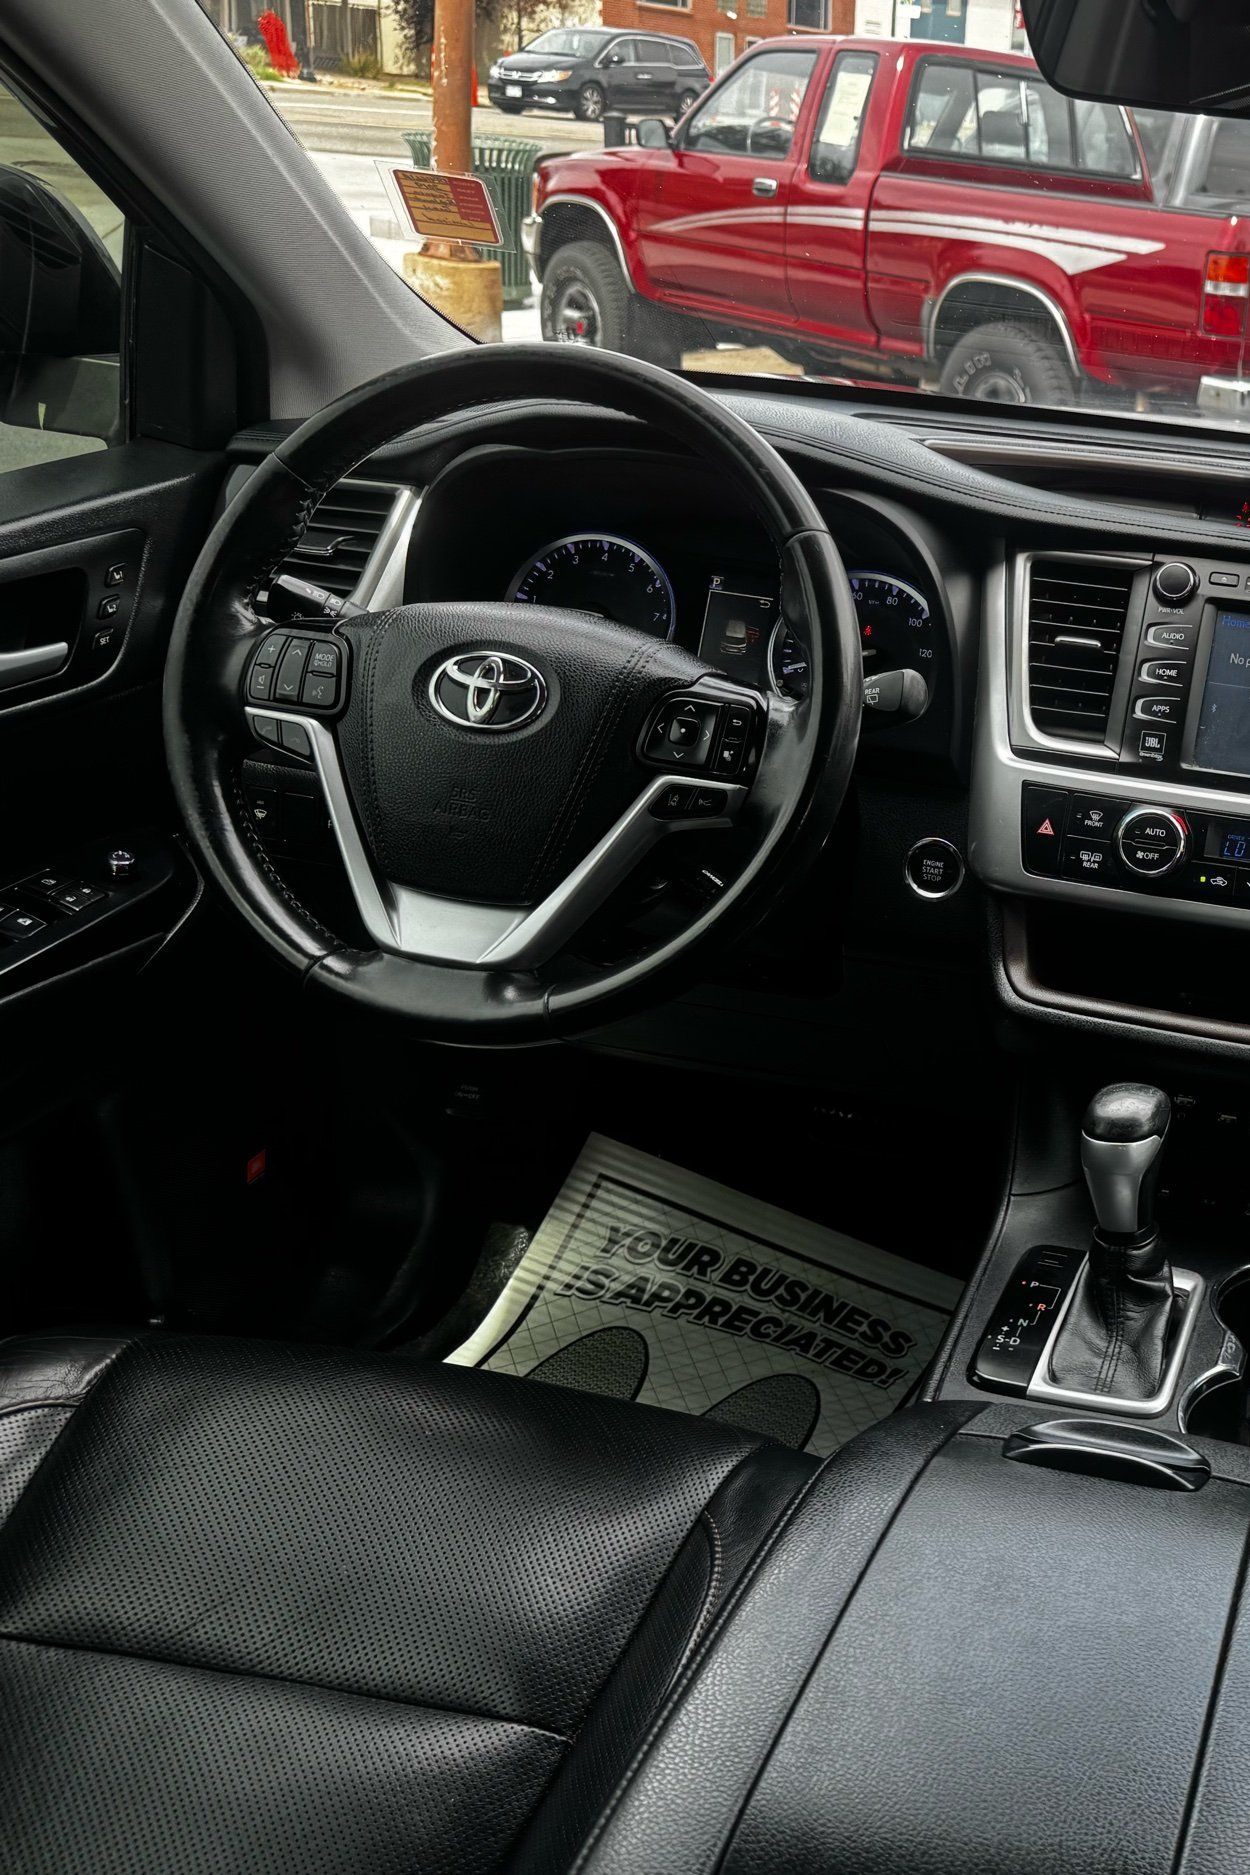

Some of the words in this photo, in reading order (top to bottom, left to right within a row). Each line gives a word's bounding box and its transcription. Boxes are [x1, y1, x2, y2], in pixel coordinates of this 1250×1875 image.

[572, 555, 580, 565] 3
[601, 553, 608, 562] 4
[628, 563, 636, 573] 5
[548, 570, 555, 580] 2
[646, 585, 654, 593] 6
[886, 596, 898, 606] 80
[652, 613, 660, 622] 7
[908, 617, 923, 627] 100
[1221, 615, 1250, 629] Home
[99, 636, 110, 645] SET
[1161, 631, 1185, 640] AUDIO
[315, 653, 335, 662] MODE
[919, 648, 933, 658] 120
[1229, 652, 1245, 666] No
[1155, 667, 1178, 677] HOME
[864, 687, 880, 695] REAR
[1151, 704, 1170, 714] APPS
[1145, 736, 1161, 748] JBL
[1084, 819, 1104, 828] FRONT
[1144, 827, 1166, 837] AUTO
[1144, 851, 1160, 861] OFF
[923, 859, 945, 868] ENGINE
[1082, 860, 1099, 869] REAR
[922, 866, 944, 875] START
[922, 873, 942, 882] STOP
[592, 1221, 725, 1287] YOUR
[720, 1250, 918, 1361] BUSINESS
[1037, 1303, 1046, 1311] R
[556, 1261, 622, 1299] IS
[604, 1270, 911, 1391] APPRECIATED!
[1017, 1318, 1029, 1327] N
[995, 1335, 1005, 1343] S
[1009, 1337, 1020, 1345] D
